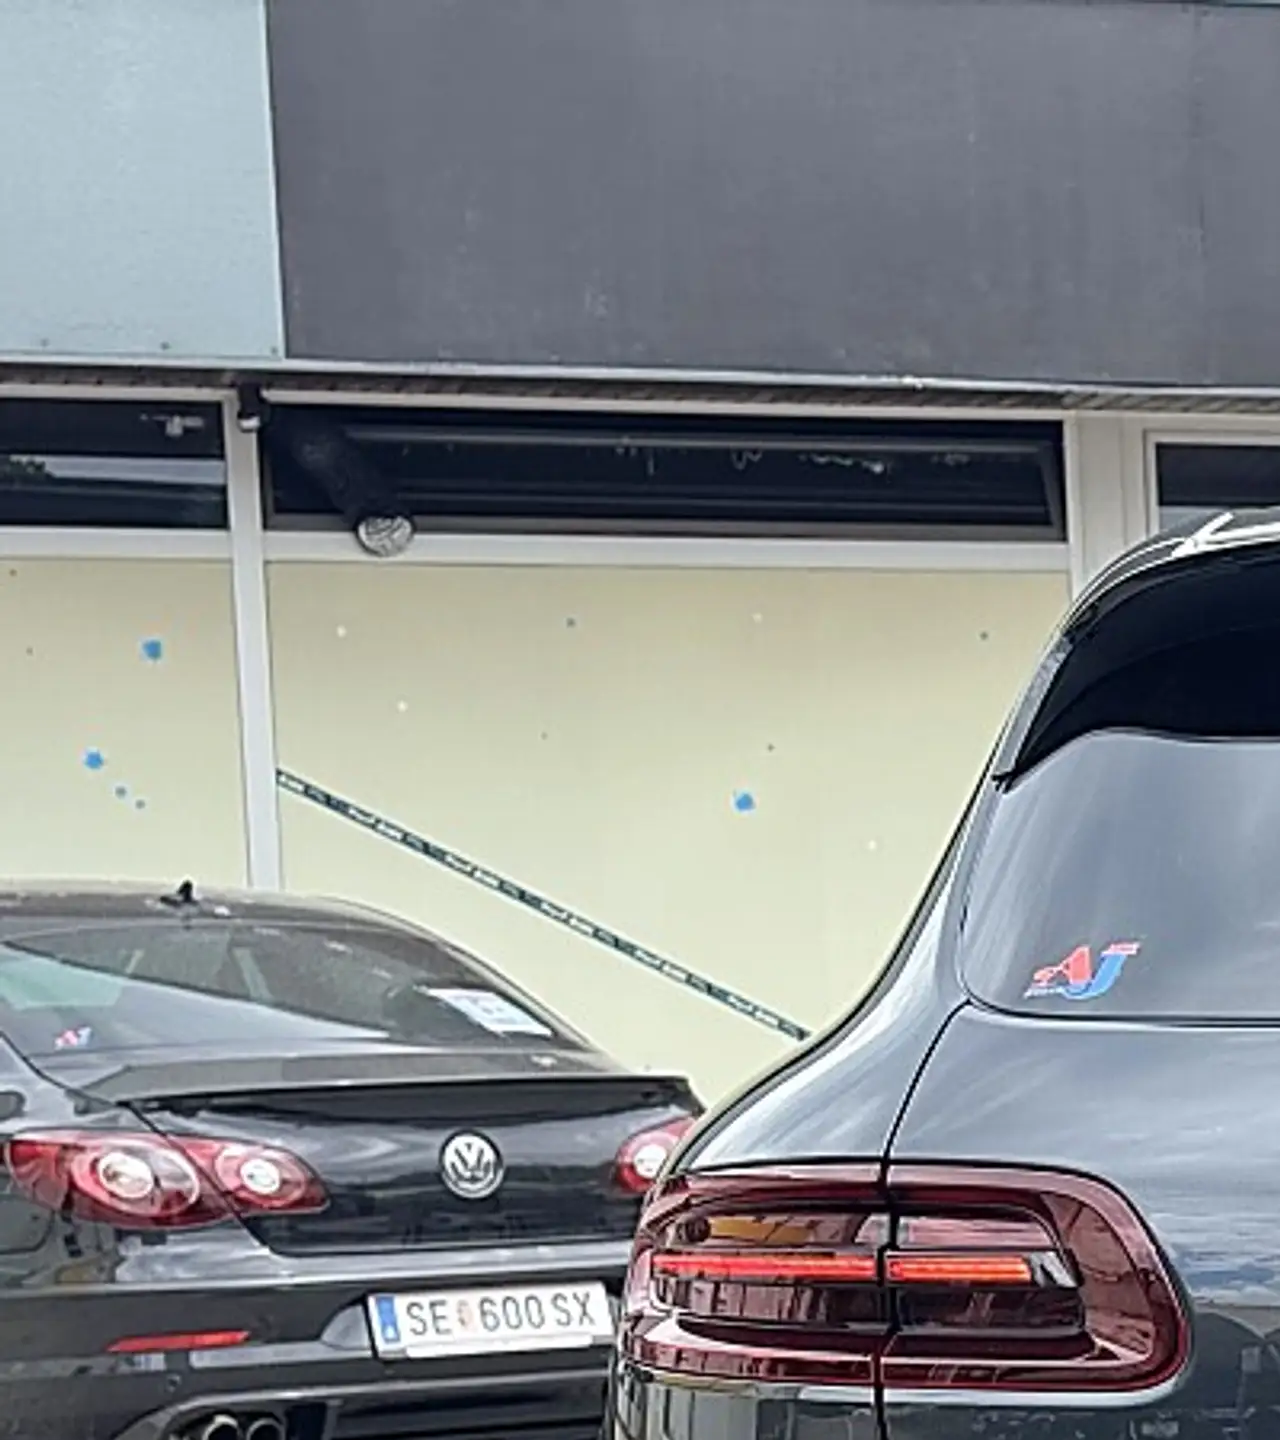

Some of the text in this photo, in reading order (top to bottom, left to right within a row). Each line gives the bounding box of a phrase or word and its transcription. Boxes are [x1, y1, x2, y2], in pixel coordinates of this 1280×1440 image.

[405, 1291, 596, 1336] SE 600 SX
